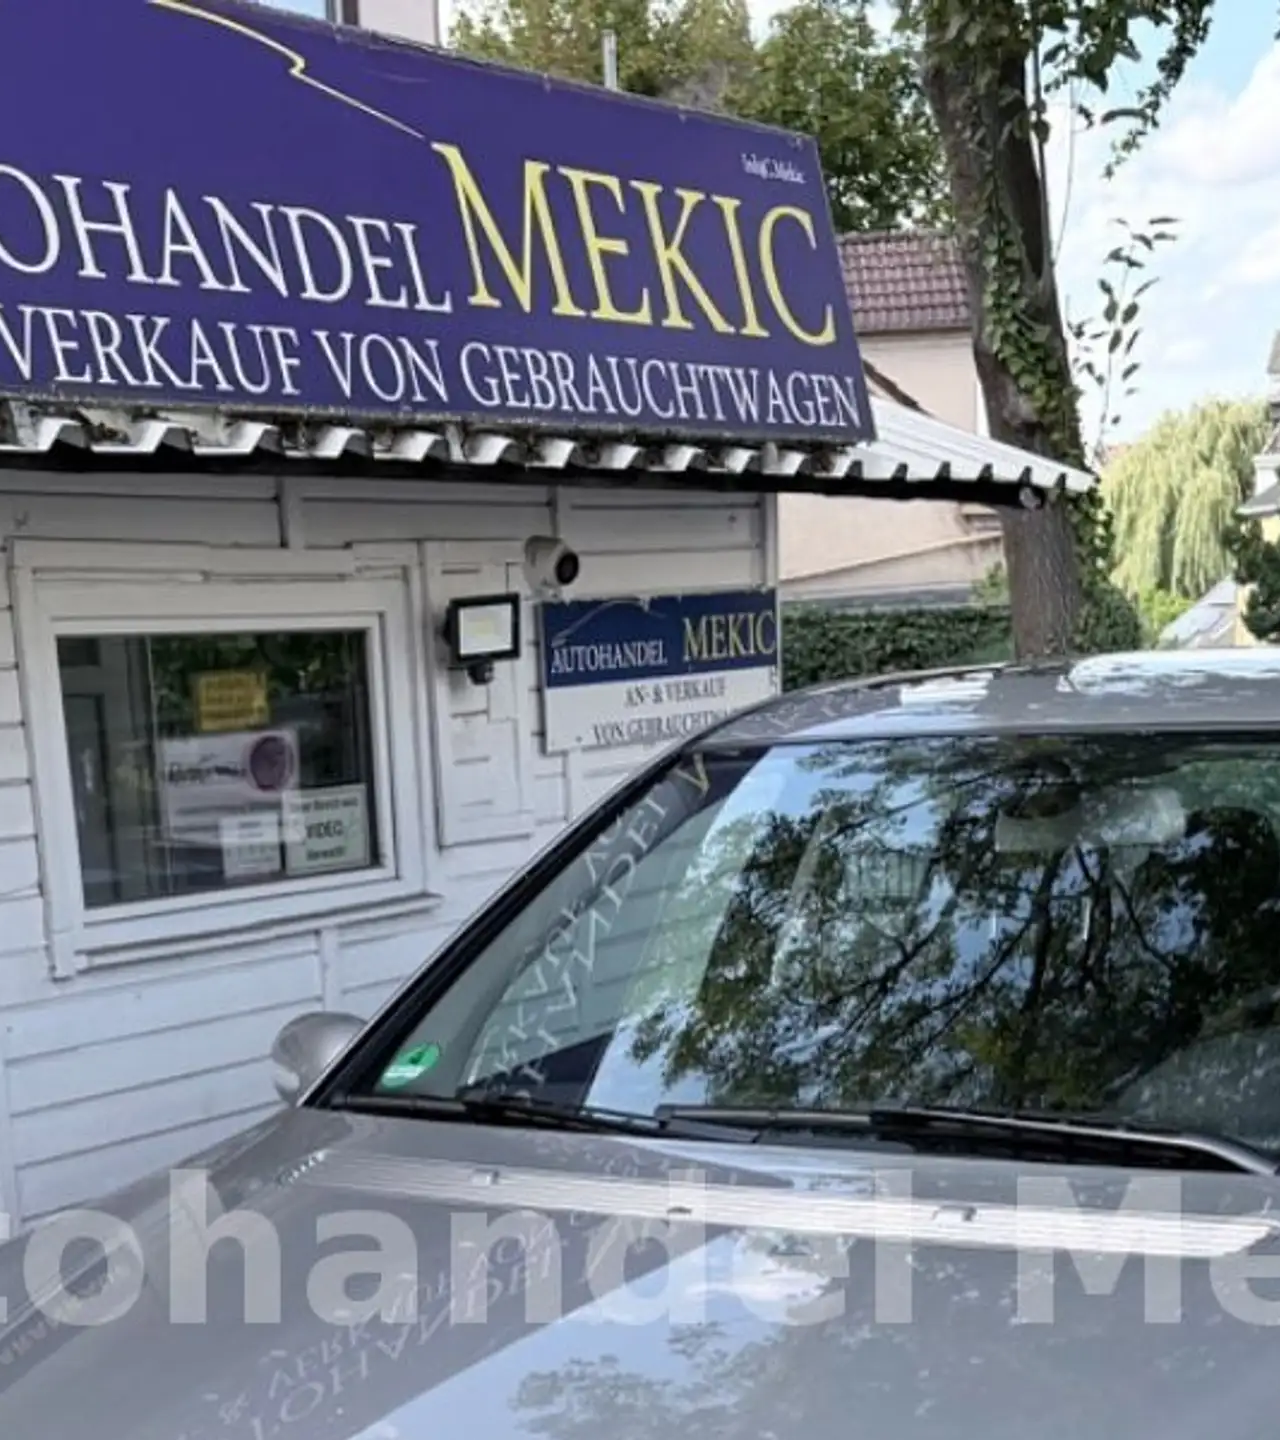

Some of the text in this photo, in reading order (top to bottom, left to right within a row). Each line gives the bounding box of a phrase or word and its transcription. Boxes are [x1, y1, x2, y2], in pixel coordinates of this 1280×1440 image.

[431, 141, 837, 346] MEKIC
[313, 330, 448, 402] VON
[459, 342, 862, 428] GEBRAUCHTWAGEN
[550, 610, 777, 674] AUTOHANDEL MEKIC
